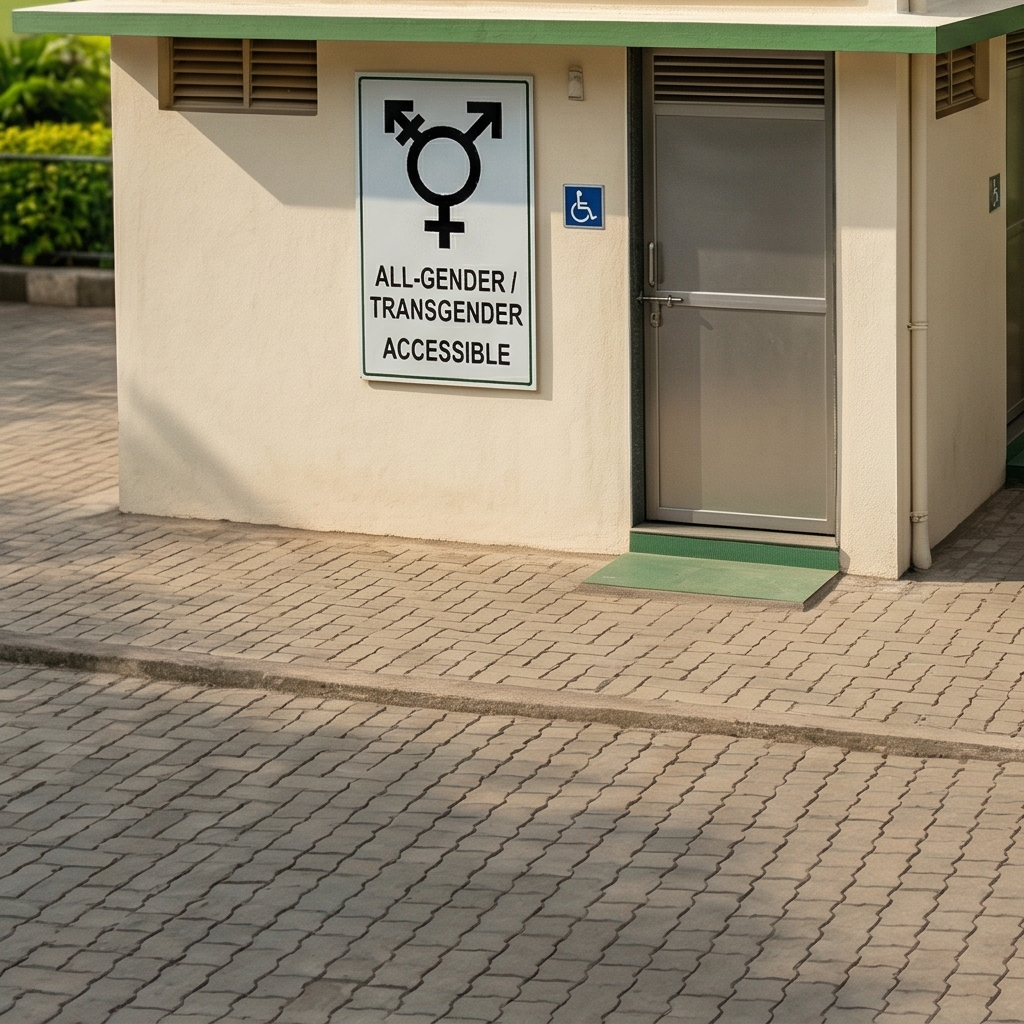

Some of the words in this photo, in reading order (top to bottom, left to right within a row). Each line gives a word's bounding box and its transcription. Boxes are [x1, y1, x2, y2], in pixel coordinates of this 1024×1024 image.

[375, 265, 505, 293] ALL-GENDER
[511, 271, 517, 293] /
[370, 296, 524, 326] TRANSGENDER
[382, 337, 511, 366] ACCESSIBLE
